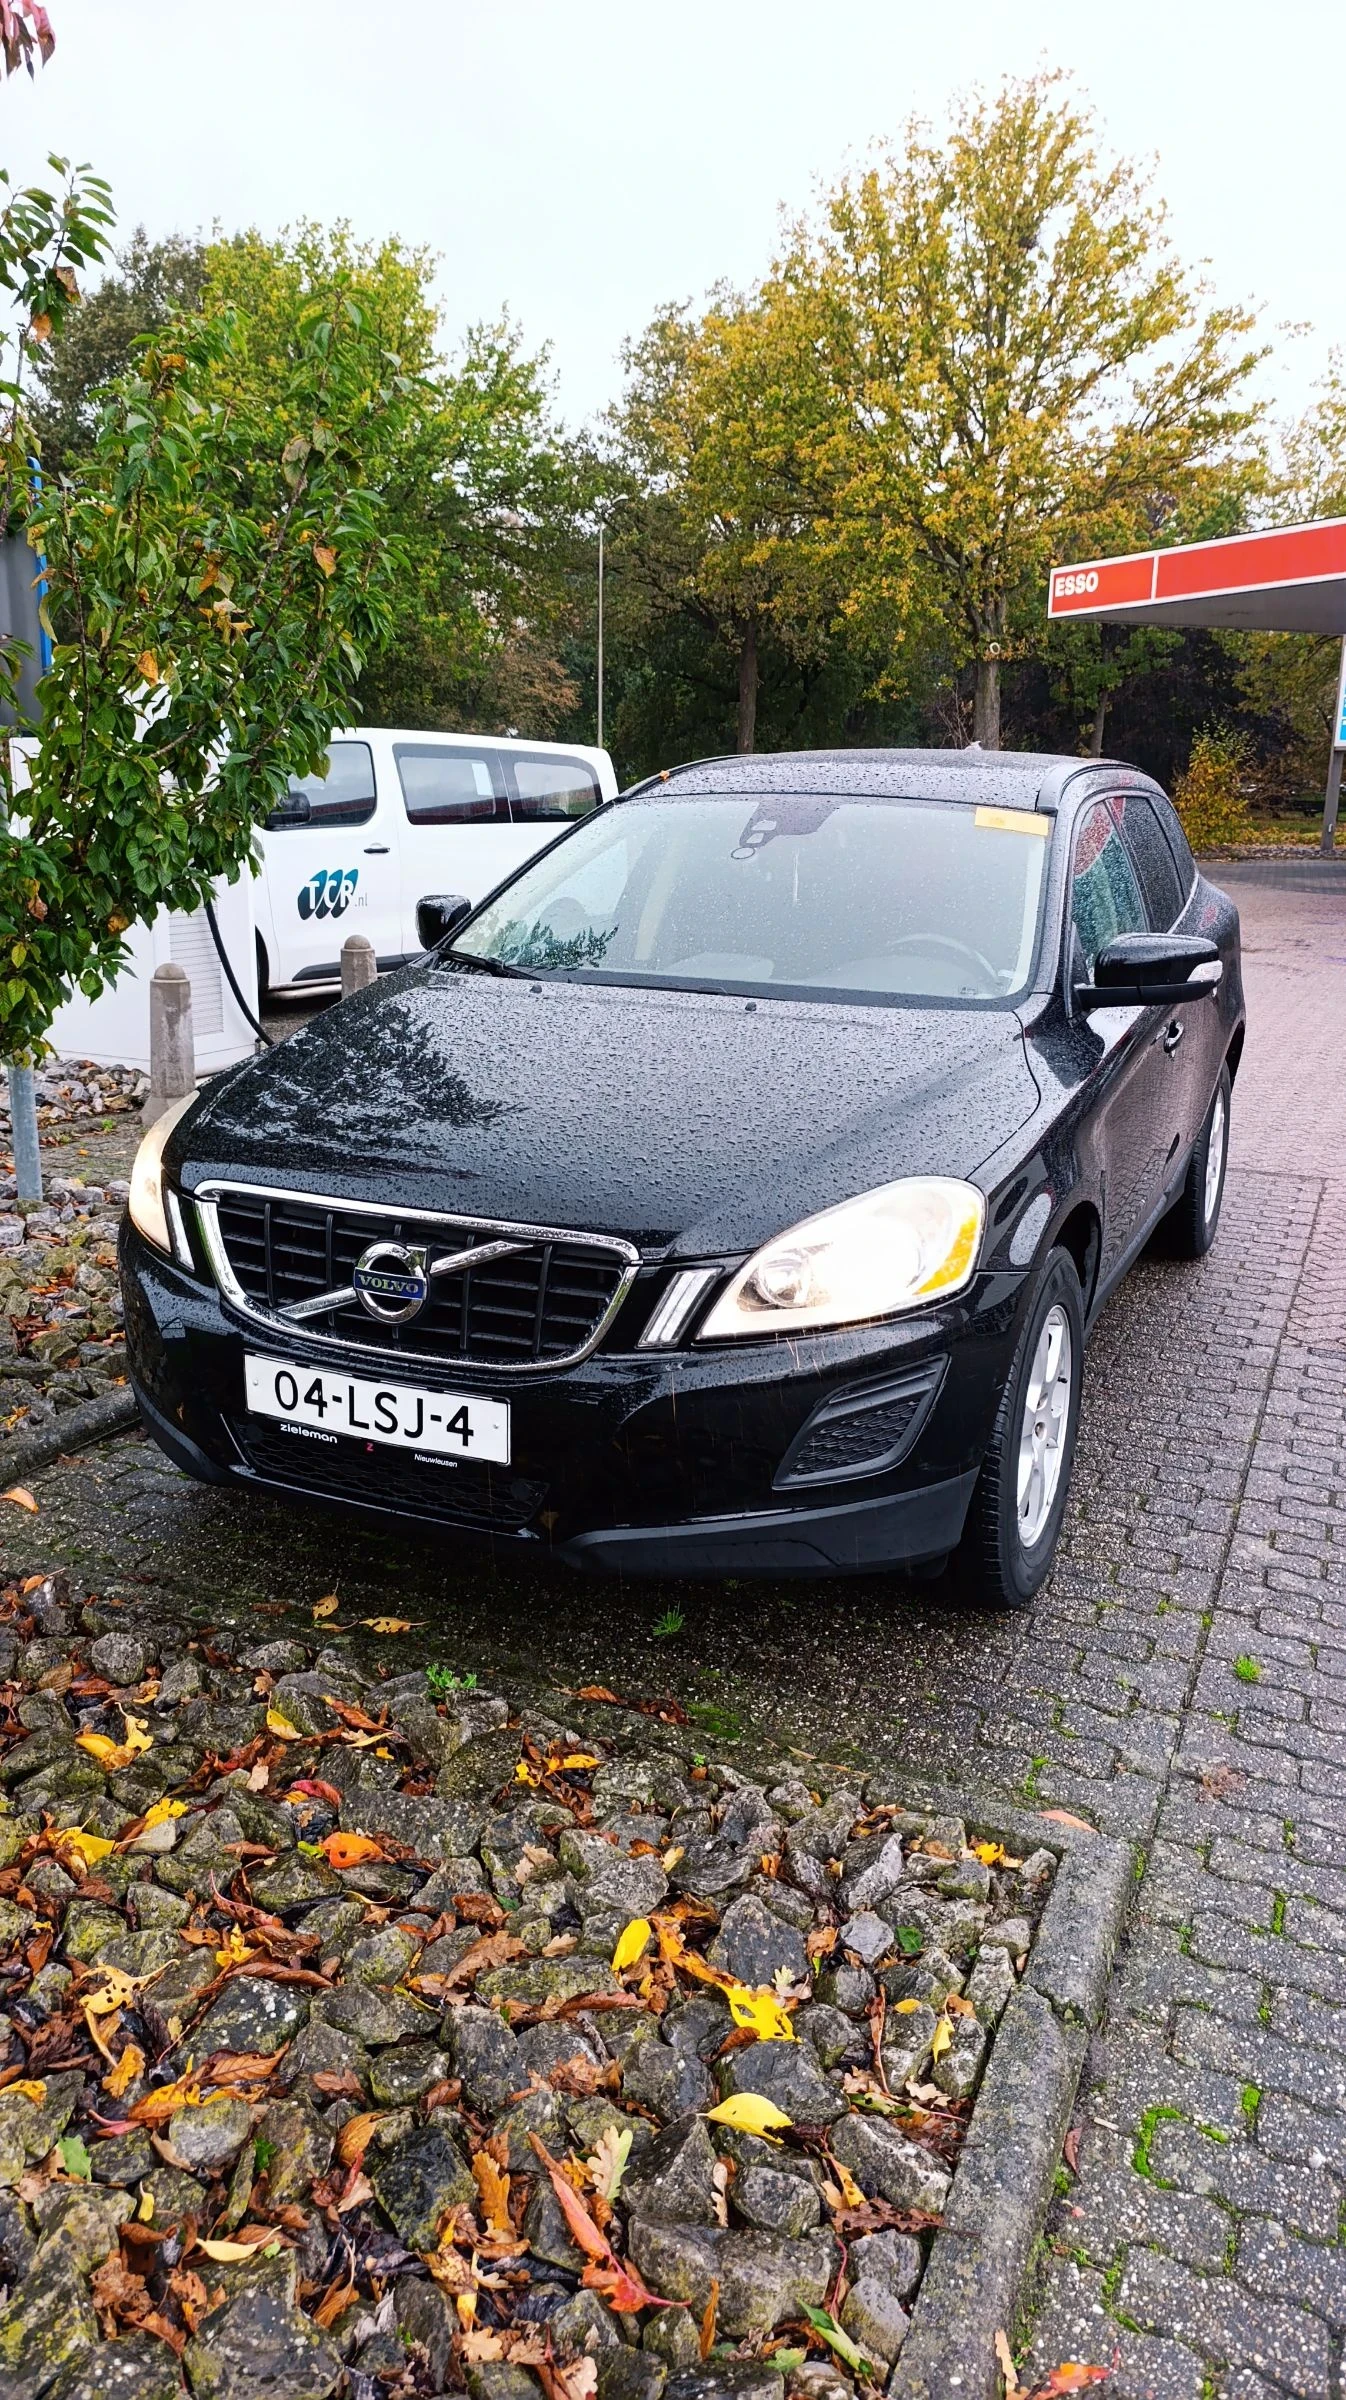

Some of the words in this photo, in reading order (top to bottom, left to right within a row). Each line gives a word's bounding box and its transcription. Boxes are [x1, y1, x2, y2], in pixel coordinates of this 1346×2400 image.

[1055, 571, 1099, 597] ESSO
[358, 1274, 419, 1294] VOLVO
[274, 1370, 474, 1447] 04-LSJ-4
[280, 1423, 338, 1443] zieleman
[414, 1453, 458, 1468] Nieuwleusen
